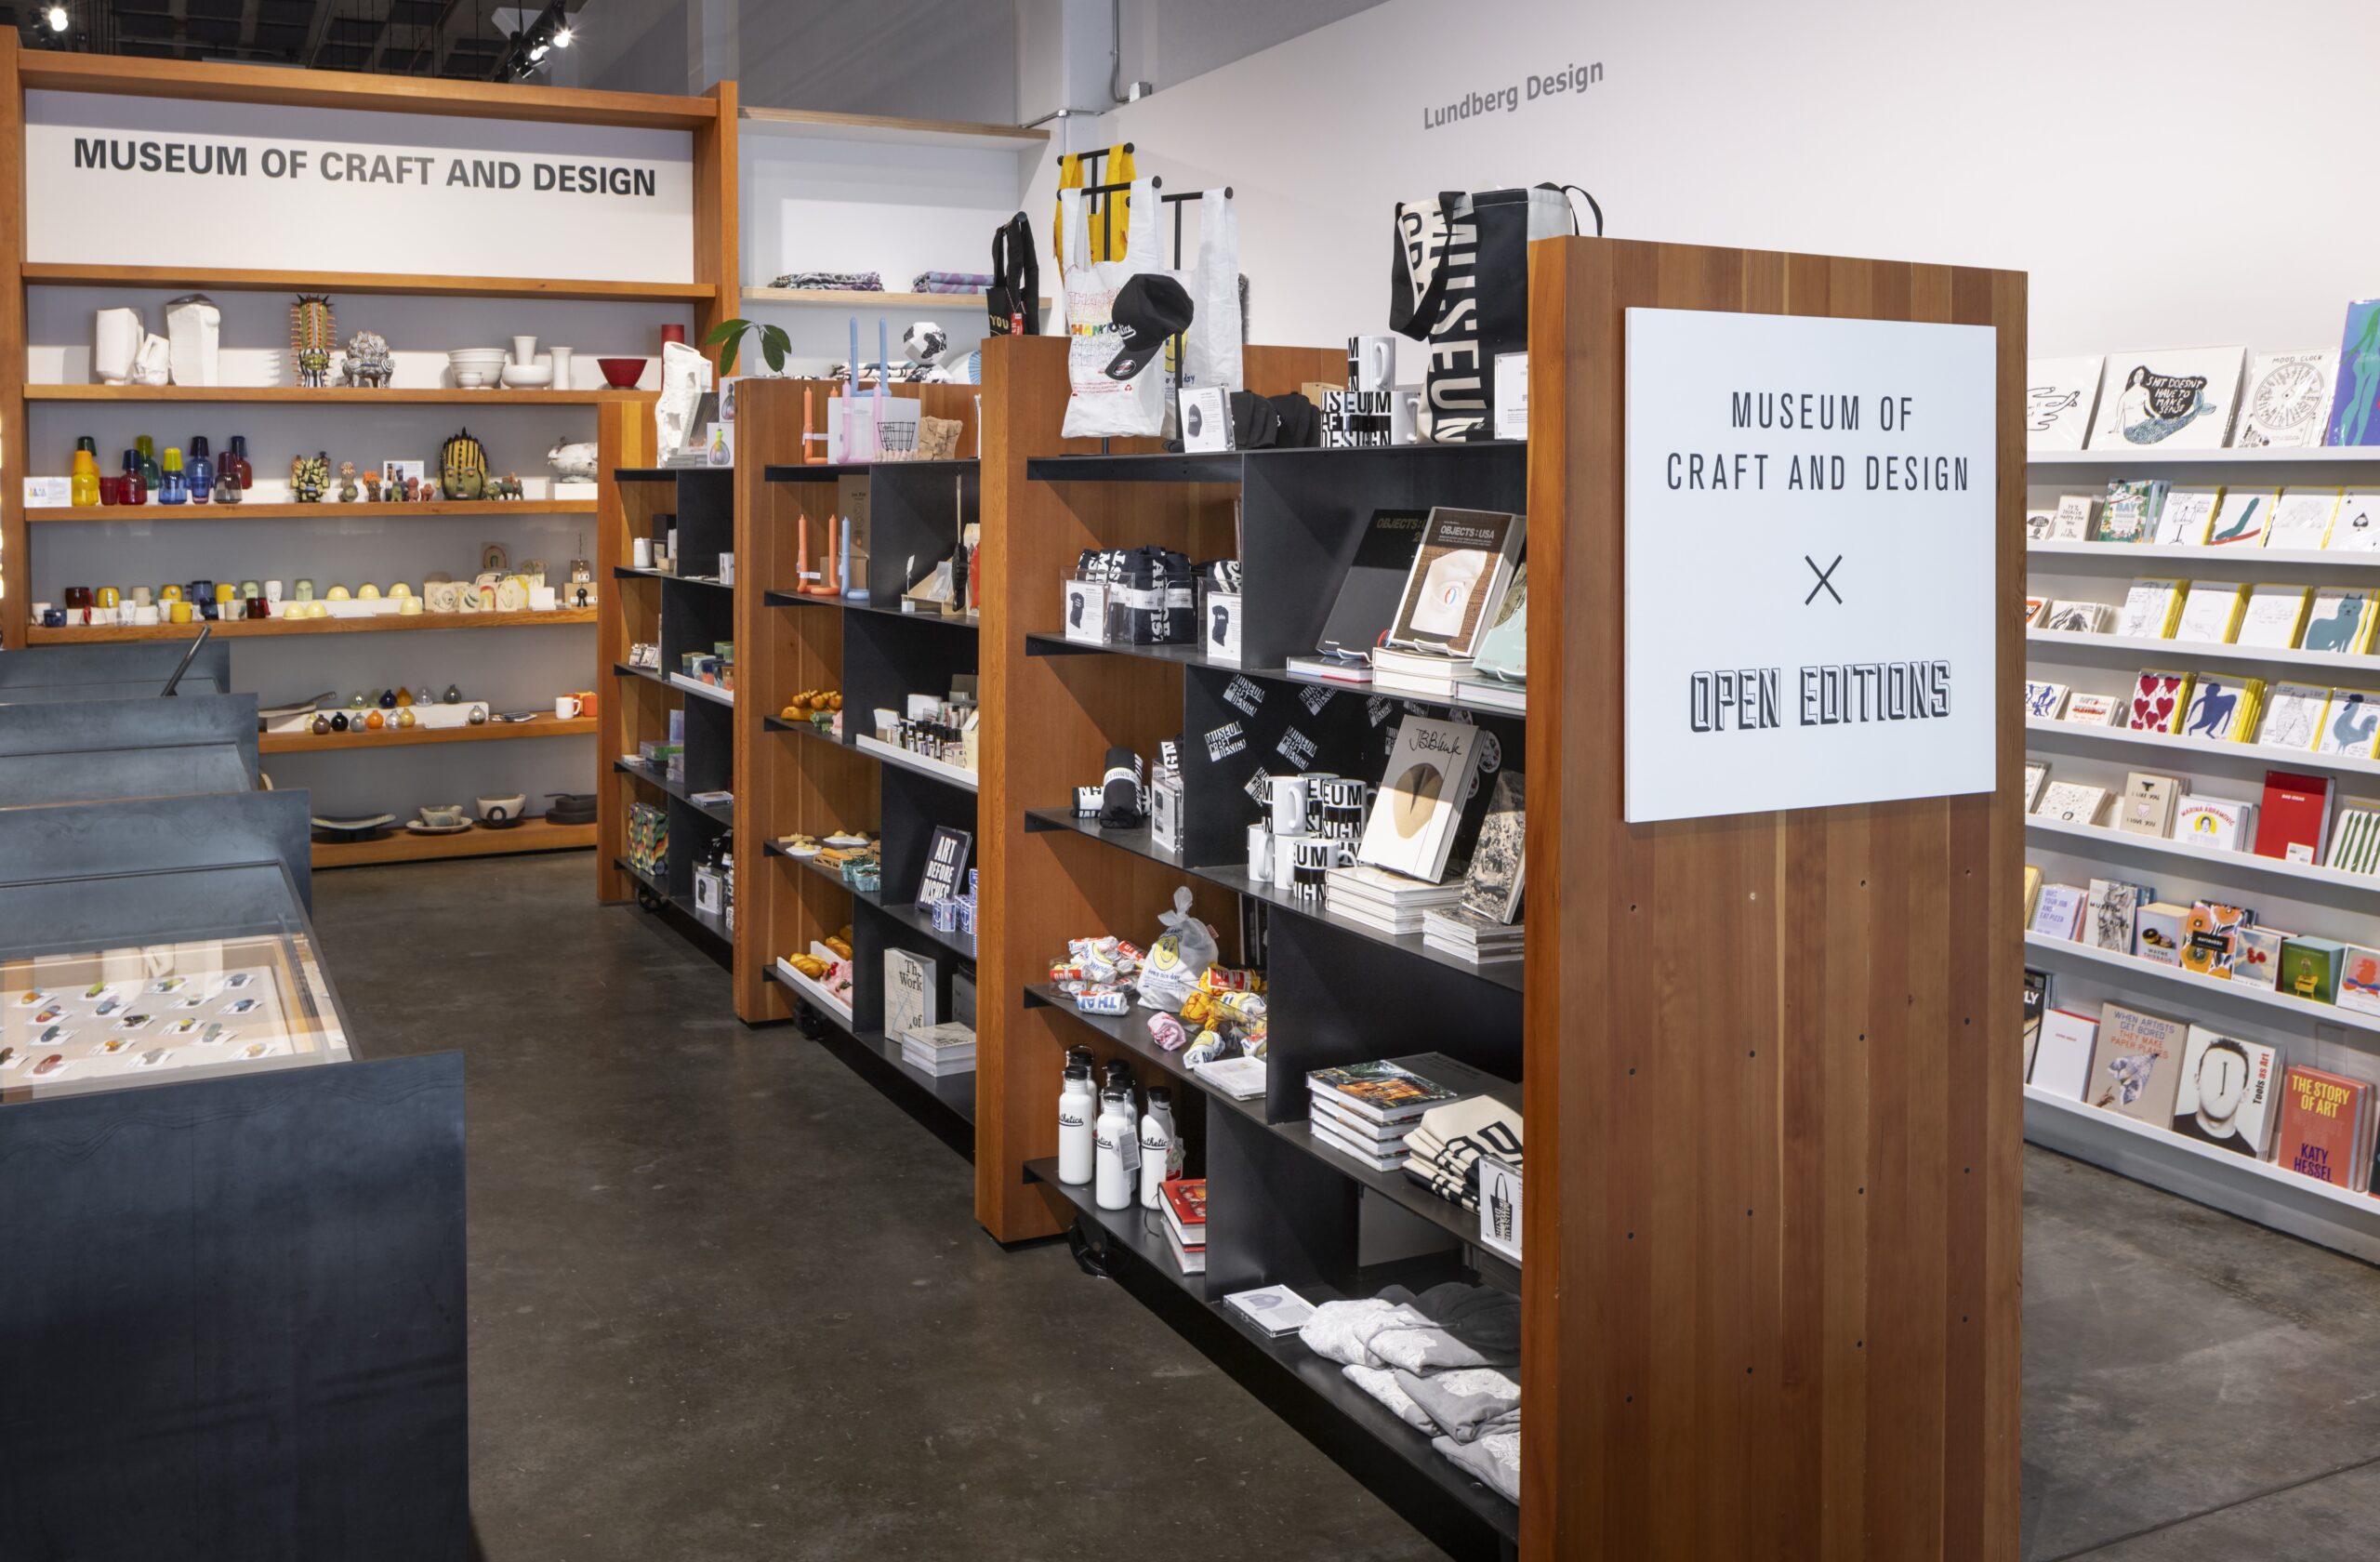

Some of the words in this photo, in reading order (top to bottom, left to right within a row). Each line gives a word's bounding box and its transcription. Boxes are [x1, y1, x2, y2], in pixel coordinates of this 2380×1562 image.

[1424, 86, 1518, 130] Lundberg
[1527, 61, 1604, 101] Design
[74, 138, 246, 176] MUSEUM
[261, 148, 308, 179] OF
[320, 152, 434, 185] CRAFT
[445, 158, 521, 190] AND
[534, 163, 655, 197] DESIGN
[990, 314, 1009, 328] YOU
[2146, 377, 2168, 388] SHIT
[2155, 390, 2178, 398] HAVE
[2178, 390, 2190, 398] TO
[2156, 398, 2184, 406] MAKE
[1732, 391, 1859, 430] MUSEUM
[1880, 396, 1912, 431] OF
[2159, 404, 2186, 414] SENSE
[1667, 452, 1768, 490] CRAFT
[1788, 455, 1844, 490] AND
[1866, 455, 1967, 491] DESIGN
[1690, 668, 1781, 733] OPEN
[1800, 660, 1951, 726] EDITIONS
[2181, 805, 2204, 817] MARINA
[934, 836, 958, 865] ART
[927, 860, 955, 883] BEFORE
[2089, 902, 2121, 912] MUSEUM
[2049, 913, 2064, 923] PIZZA
[2148, 947, 2168, 958] WAYNE
[899, 972, 922, 992] Work
[912, 1013, 922, 1028] of
[2114, 1011, 2138, 1023] WHEN
[2141, 1017, 2175, 1034] ARTISTS
[2120, 1022, 2135, 1032] GET
[2138, 1025, 2164, 1039] BORED
[2110, 1036, 2135, 1050] PAPER
[2138, 1043, 2169, 1060] PLANES
[2120, 1030, 2139, 1041] THEY
[2141, 1033, 2163, 1048] MAKE
[2262, 1052, 2270, 1067] Art
[2260, 1067, 2268, 1079] as
[2253, 1080, 2266, 1105] Tools
[2292, 1075, 2312, 1095] THE
[2313, 1081, 2351, 1106] STORY
[2300, 1094, 2315, 1111] OF
[2316, 1101, 2339, 1119] ART
[2301, 1143, 2329, 1165] KATY
[2294, 1157, 2333, 1183] HESSEL
